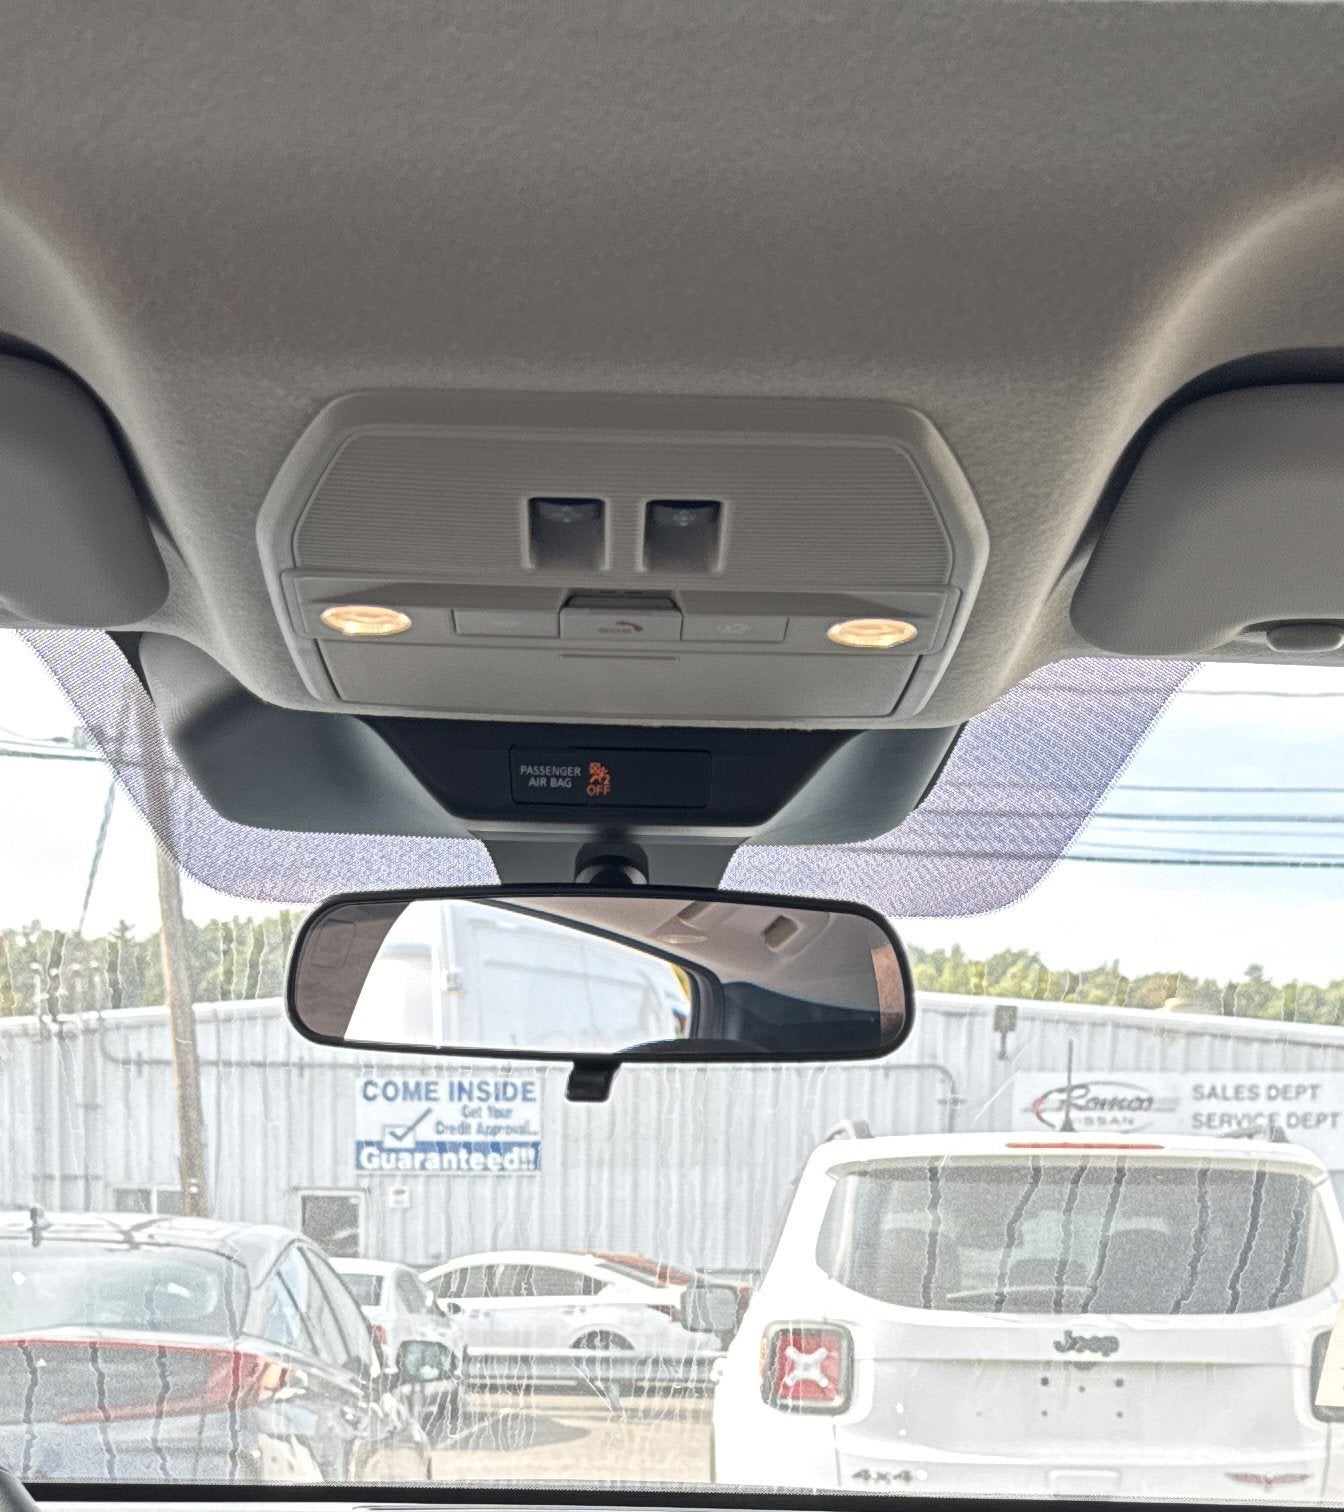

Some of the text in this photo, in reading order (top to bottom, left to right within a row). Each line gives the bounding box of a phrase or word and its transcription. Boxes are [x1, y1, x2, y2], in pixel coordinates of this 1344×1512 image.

[520, 764, 582, 777] PASSENGER
[528, 777, 573, 788] AIR BAG
[586, 785, 611, 796] OFF
[362, 1080, 537, 1103] COME INSIDE
[1191, 1084, 1324, 1102] SALES DEPT
[461, 1104, 513, 1118] Get Your
[435, 1120, 471, 1136] Credit
[1191, 1112, 1343, 1130] SERVICE DEPT
[359, 1149, 535, 1171] Guaranteed!!
[1052, 1330, 1120, 1357] Jeep
